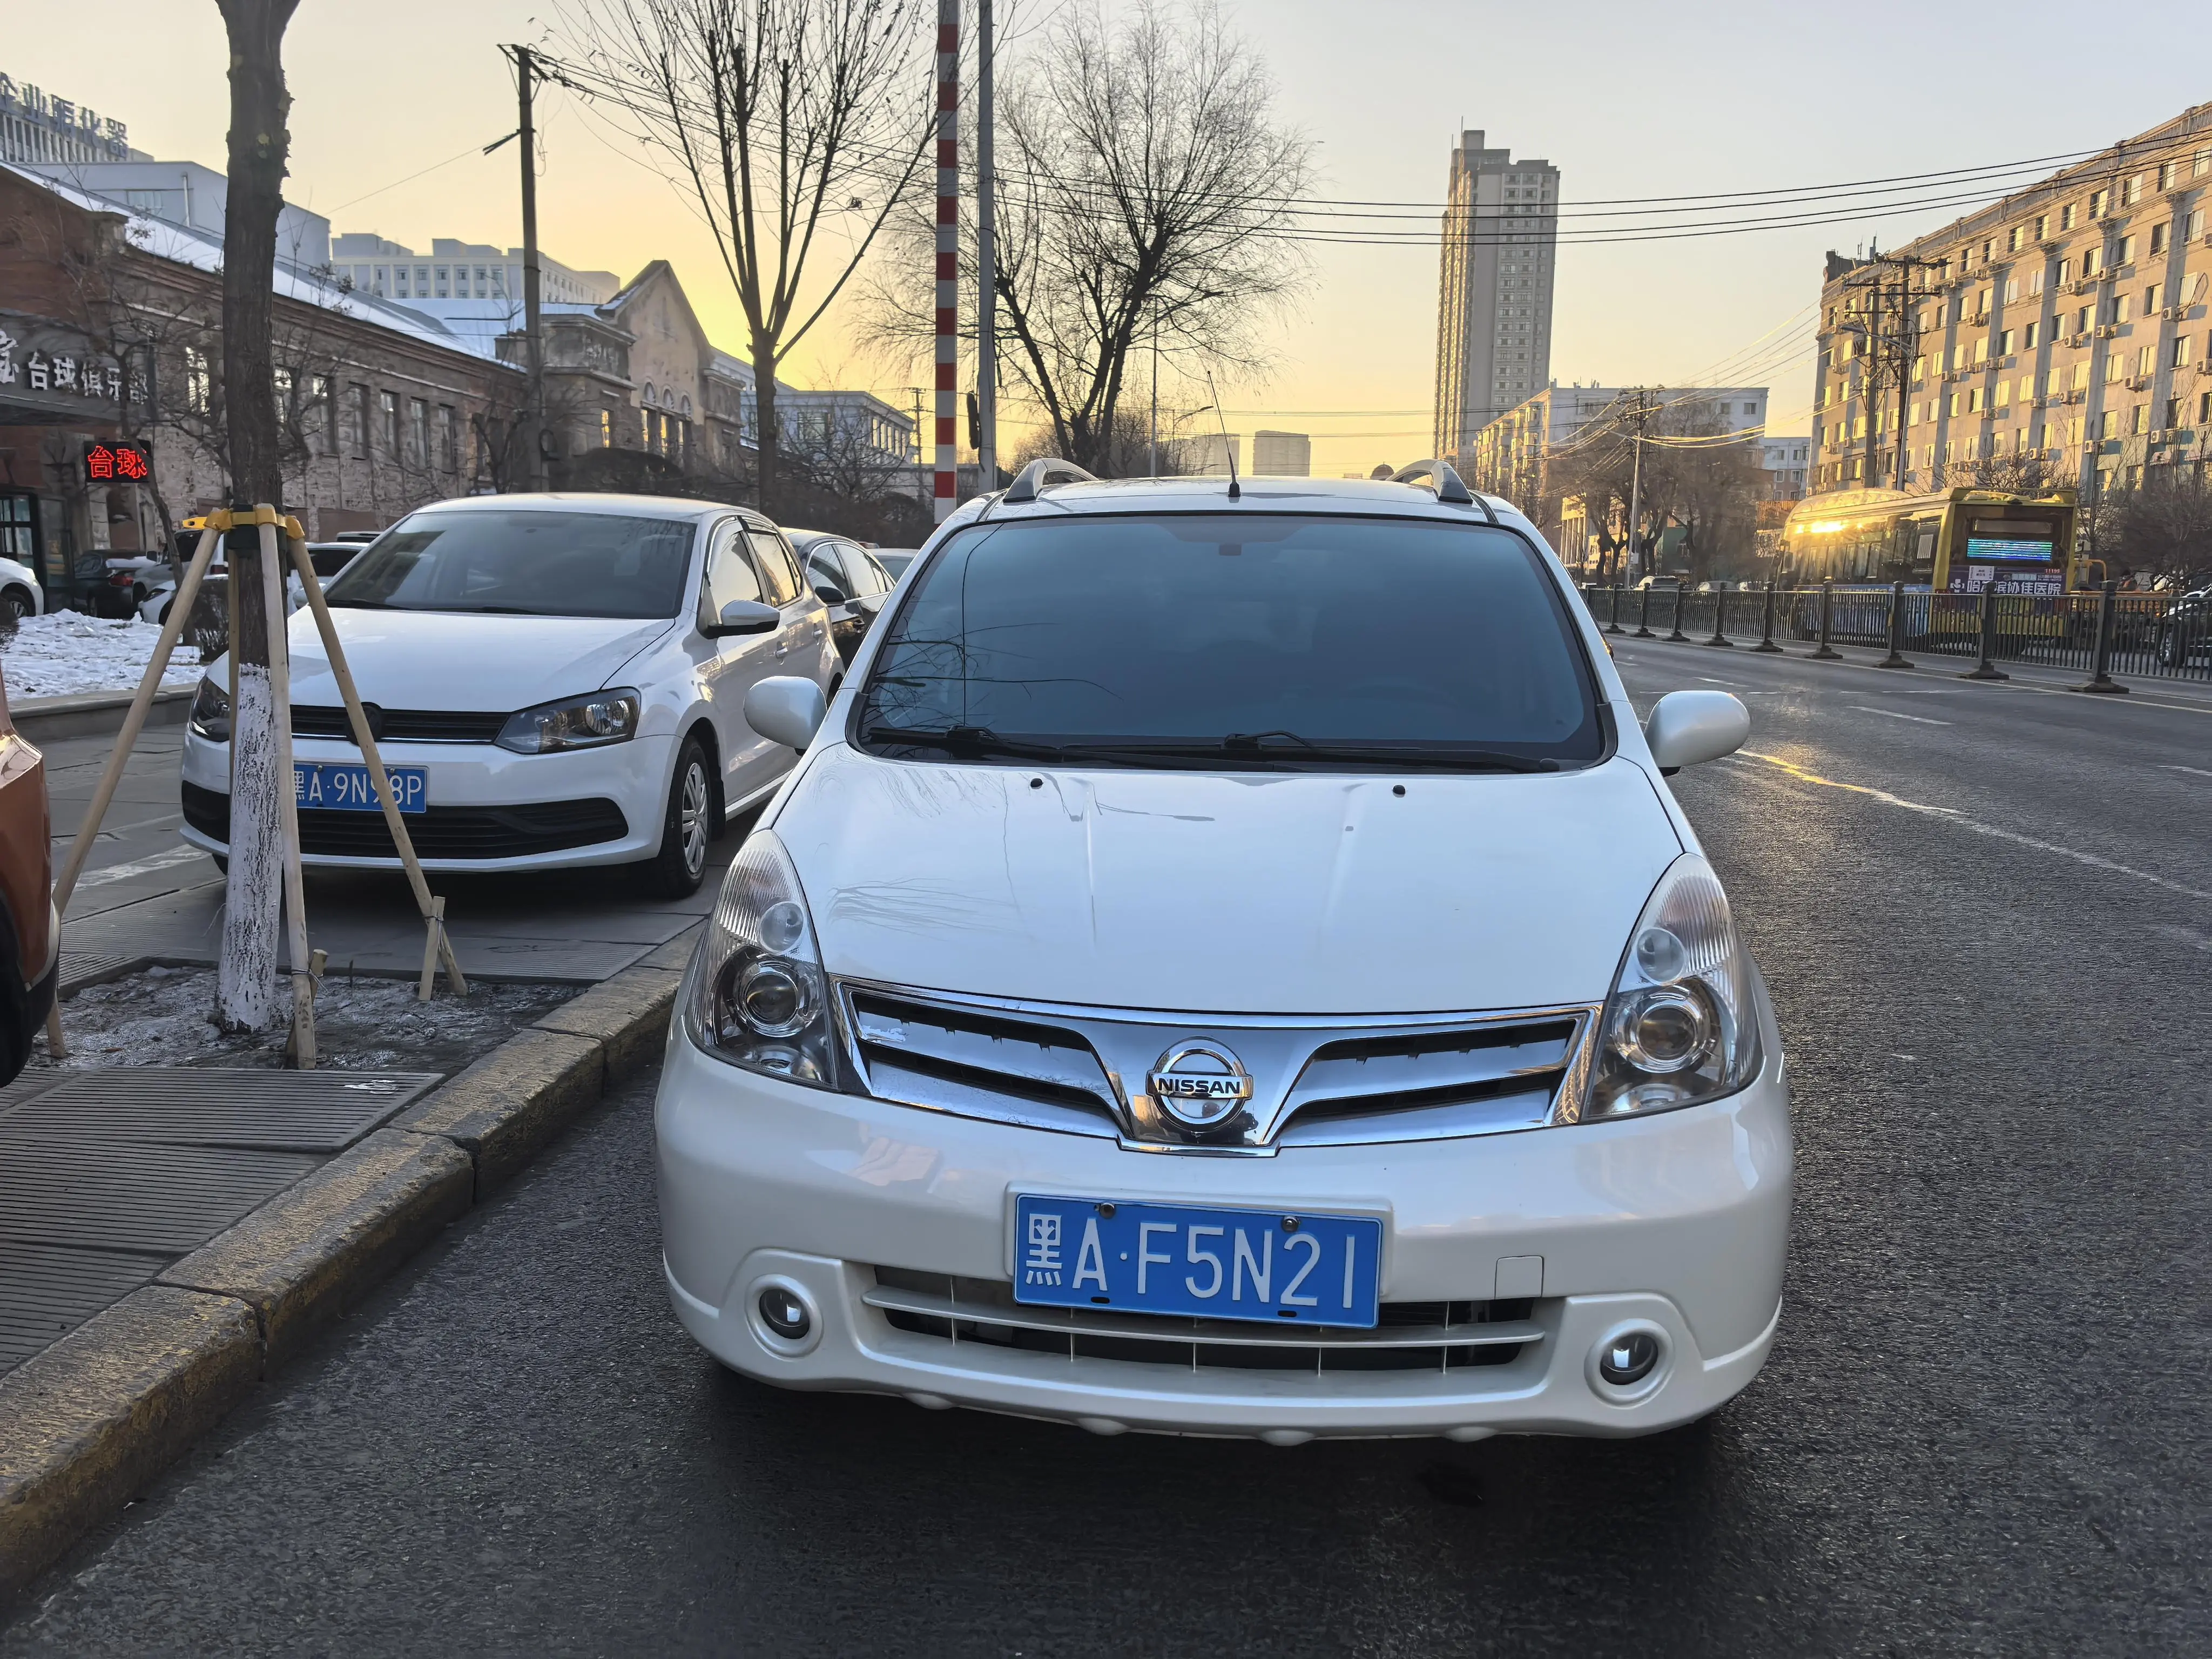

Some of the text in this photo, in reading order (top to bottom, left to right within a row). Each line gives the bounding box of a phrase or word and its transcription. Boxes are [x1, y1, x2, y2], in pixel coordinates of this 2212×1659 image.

[87, 445, 147, 479] 台球
[1966, 581, 2061, 595] 哈滨协佳医院
[1158, 1077, 1240, 1094] NISSAN
[1025, 1213, 1355, 1309] 黑A·F5N21
